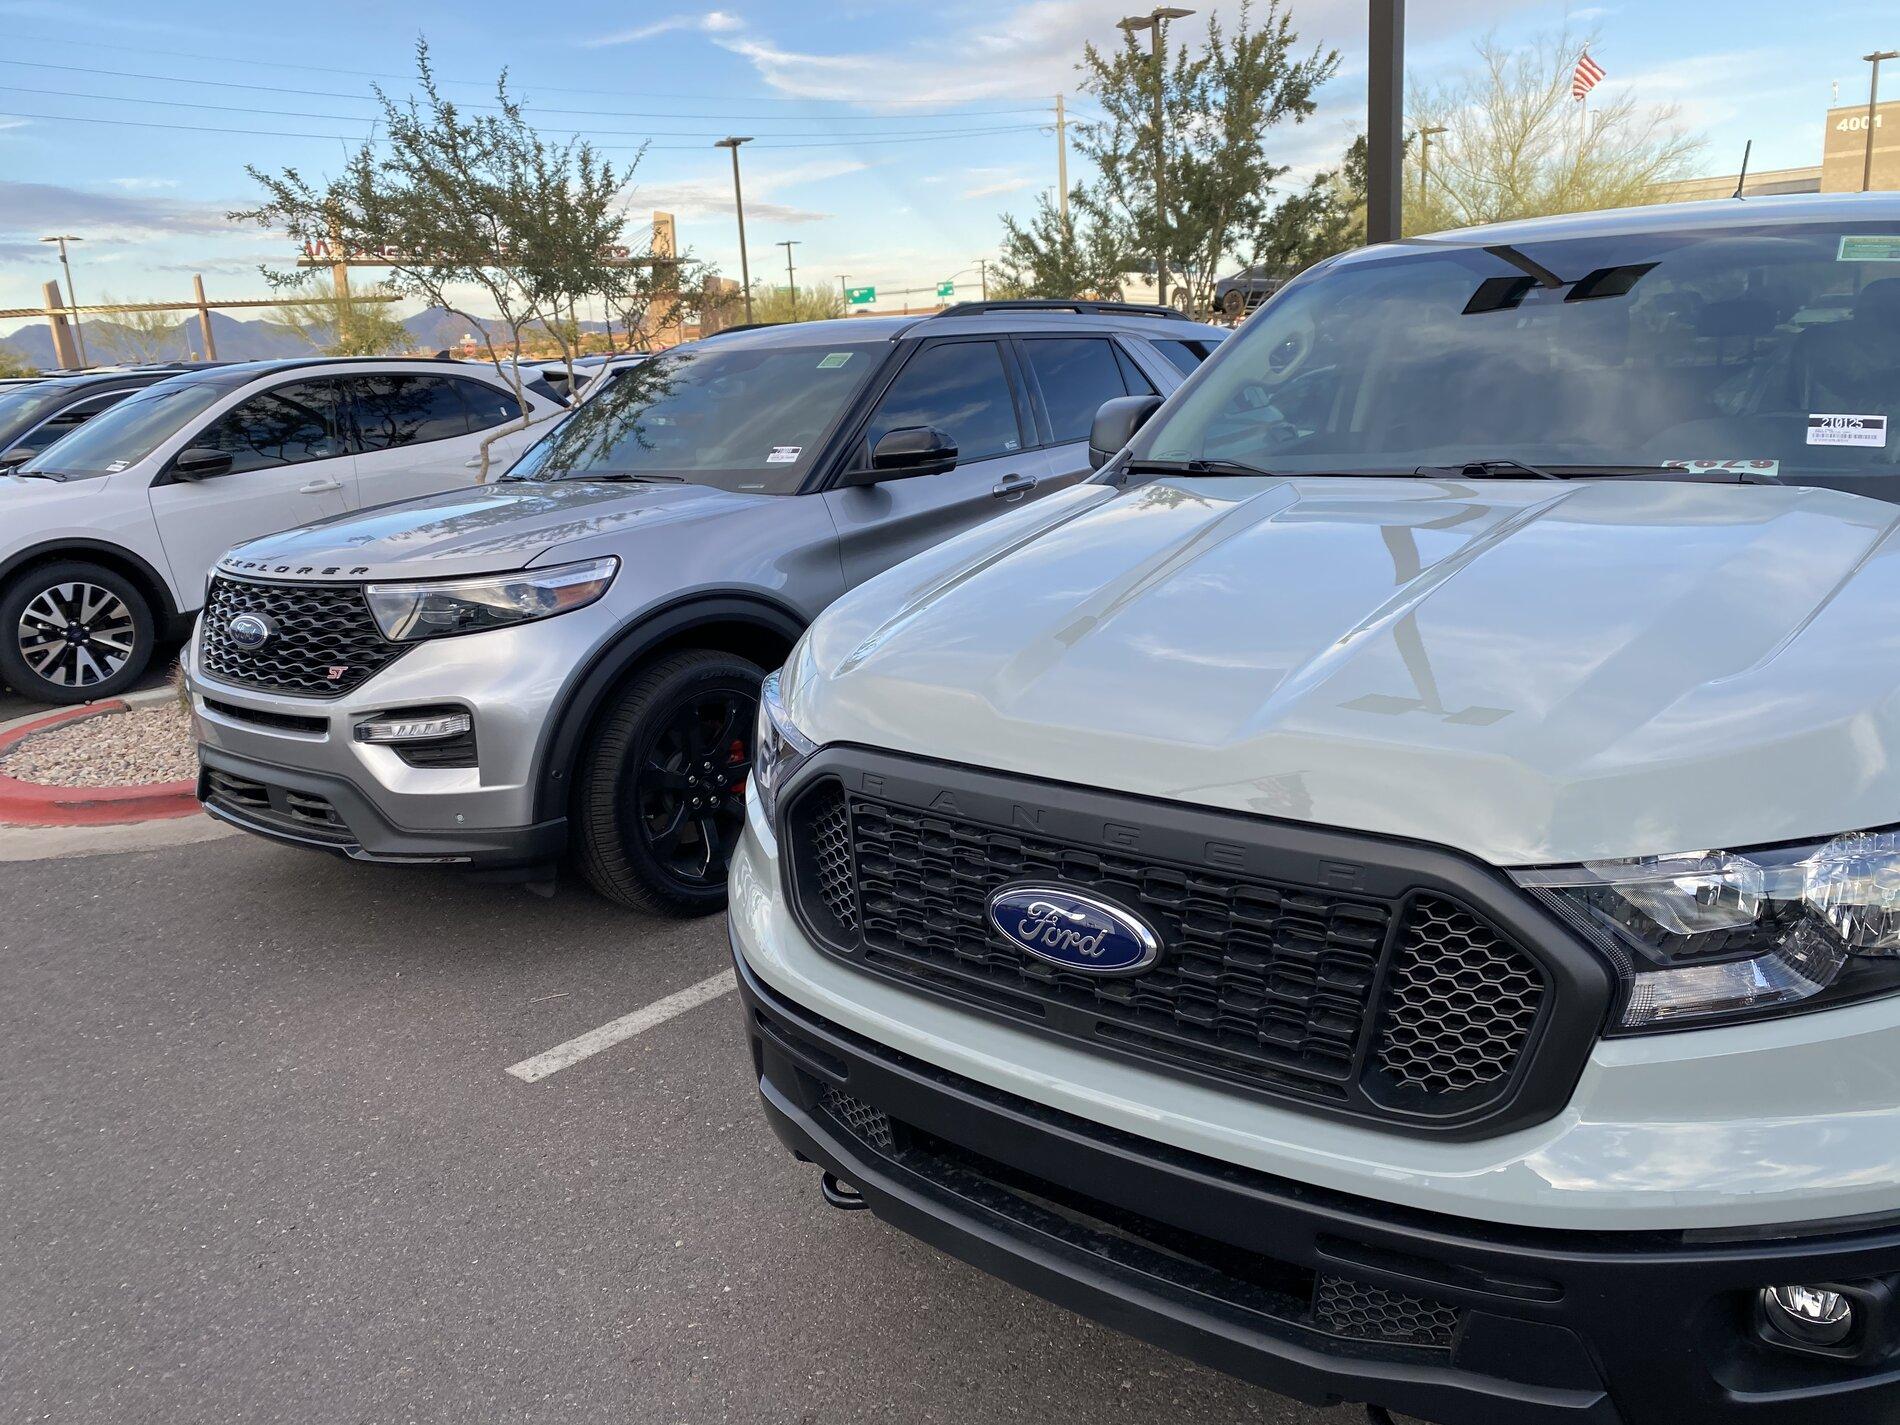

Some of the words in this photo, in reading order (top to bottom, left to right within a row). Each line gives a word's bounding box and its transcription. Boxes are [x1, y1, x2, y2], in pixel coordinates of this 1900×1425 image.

[1836, 114, 1883, 132] 4001
[1821, 417, 1864, 430] 210125
[221, 558, 370, 576] EXPLORER
[326, 665, 349, 680] ST
[861, 772, 1366, 891] RANGER
[1017, 901, 1107, 959] Ford
